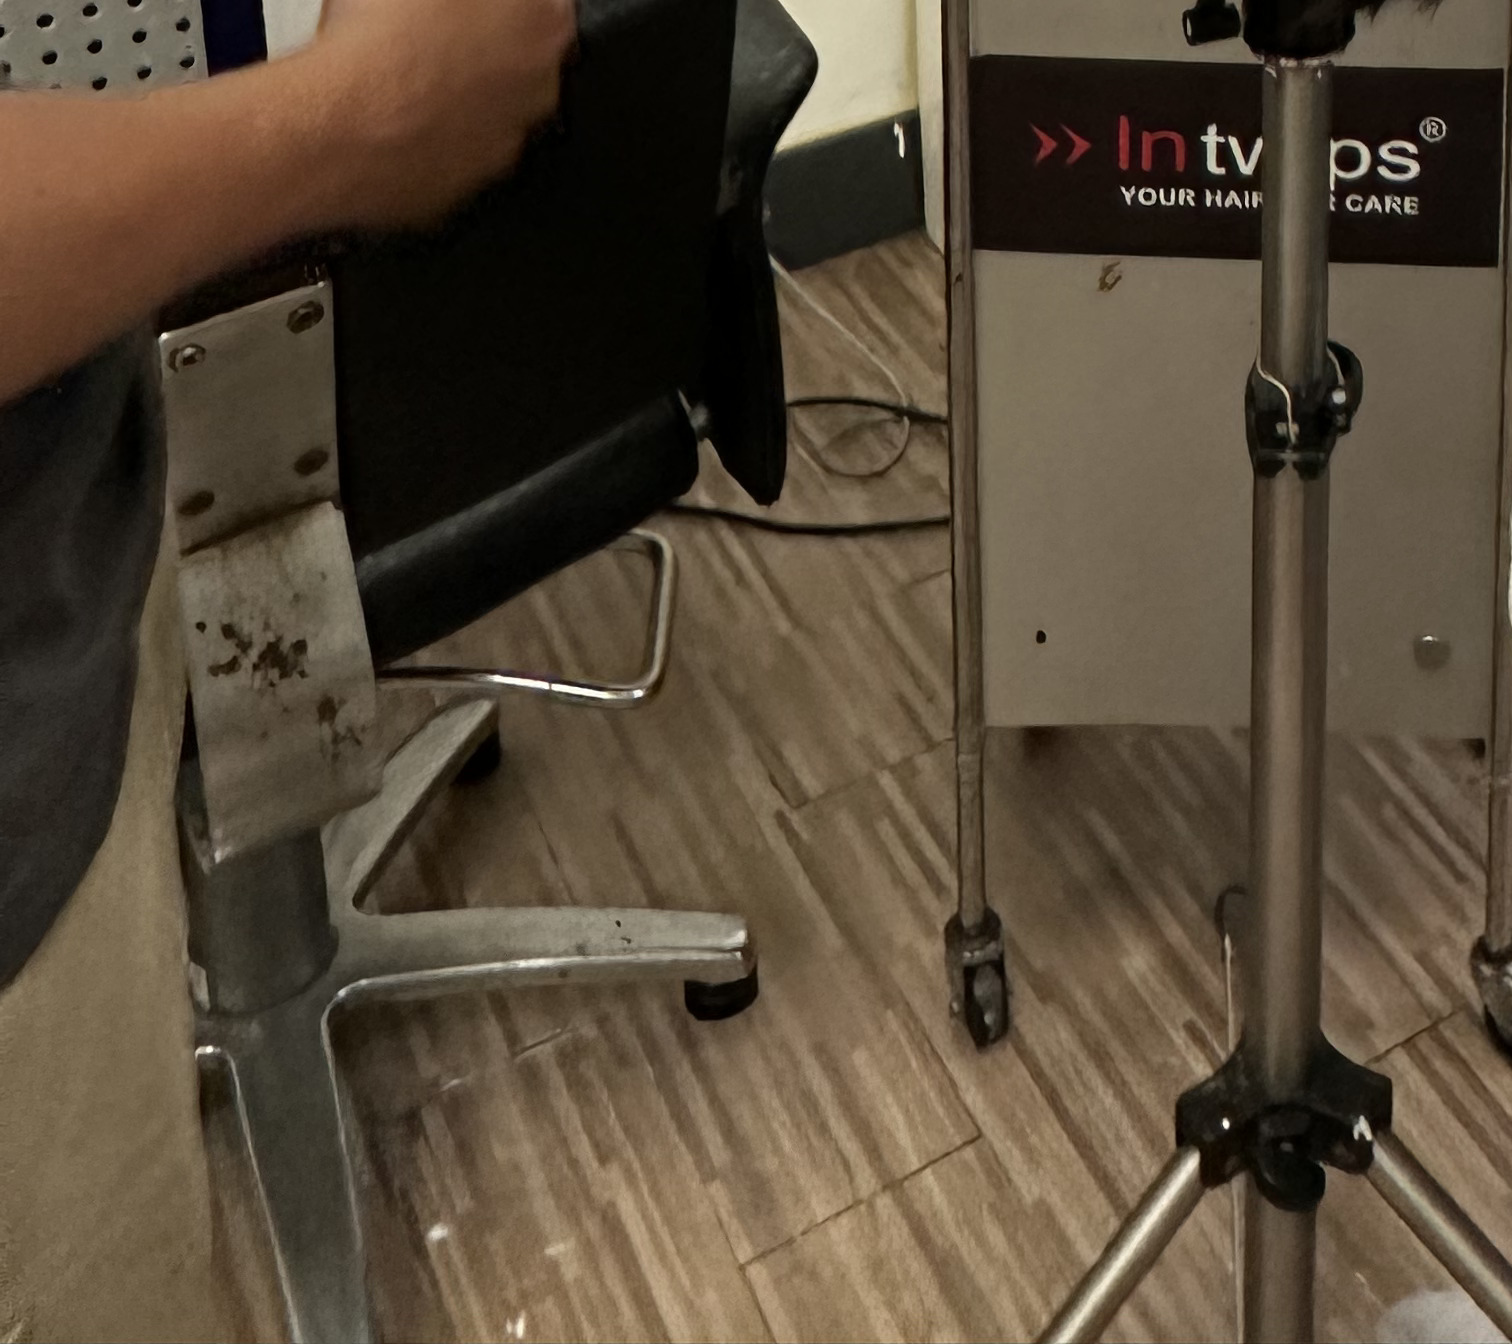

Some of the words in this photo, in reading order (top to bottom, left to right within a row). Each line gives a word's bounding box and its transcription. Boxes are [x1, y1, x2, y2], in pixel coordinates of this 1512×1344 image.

[1119, 185, 1196, 207] YOUR
[1204, 188, 1264, 210] HAIR
[1345, 193, 1420, 216] CARE
